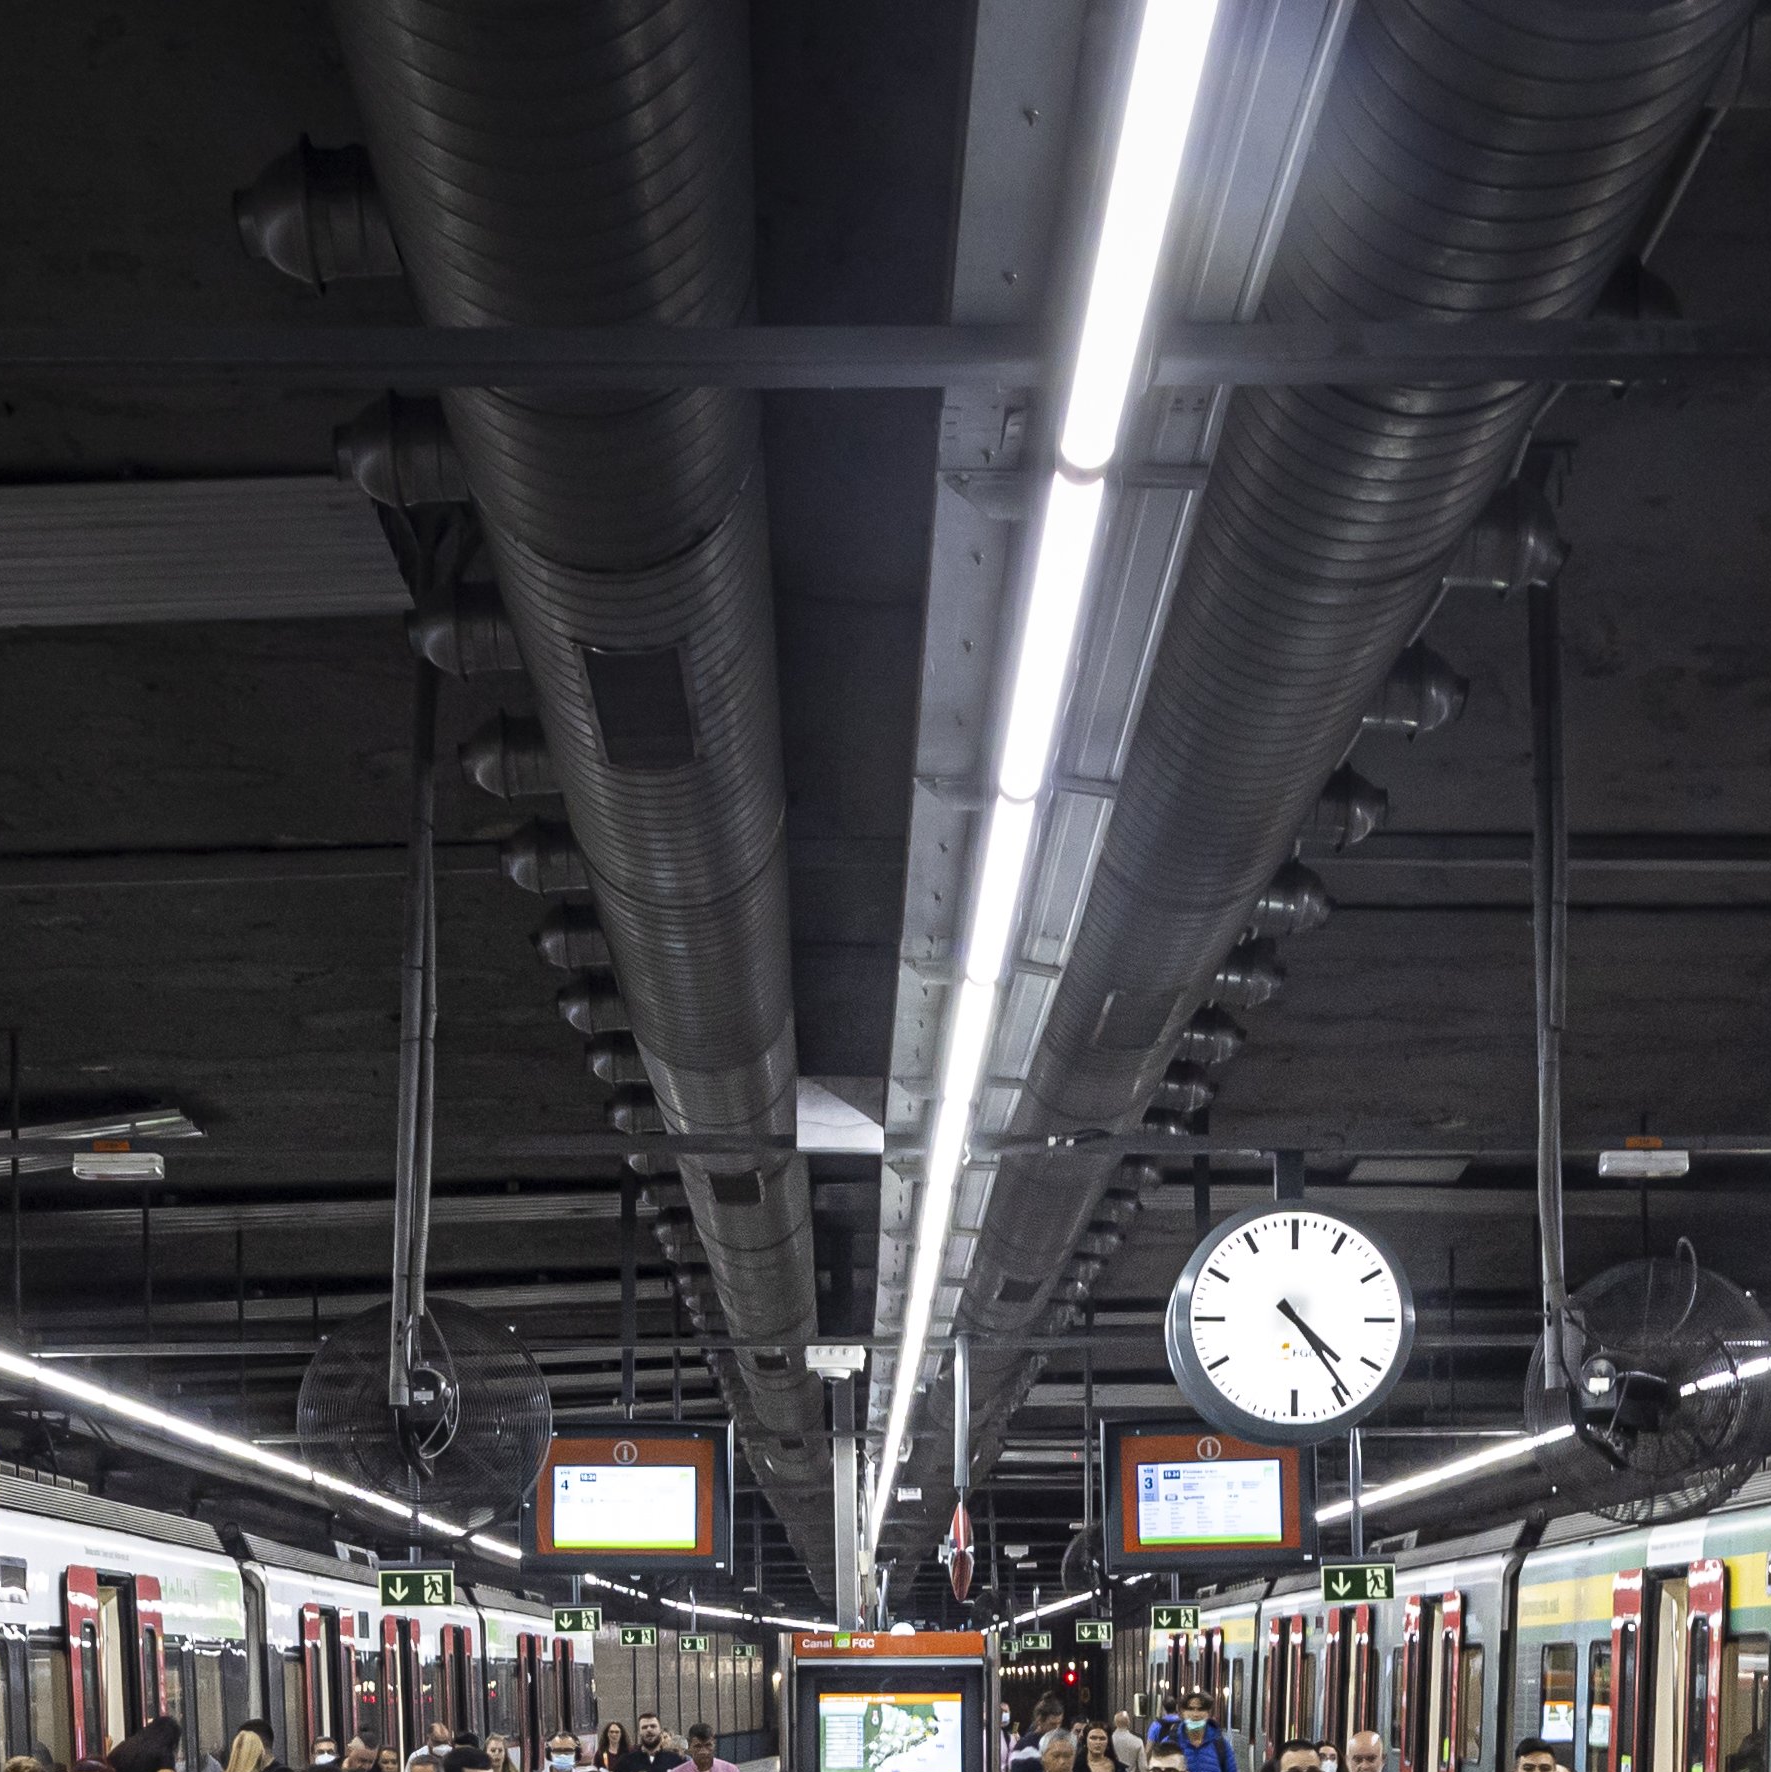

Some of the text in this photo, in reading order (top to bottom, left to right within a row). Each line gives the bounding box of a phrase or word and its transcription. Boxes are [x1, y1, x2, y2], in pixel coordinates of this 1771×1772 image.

[561, 1480, 569, 1490] 4
[1144, 1477, 1153, 1489] 3
[802, 1638, 875, 1648] Canal FGC
